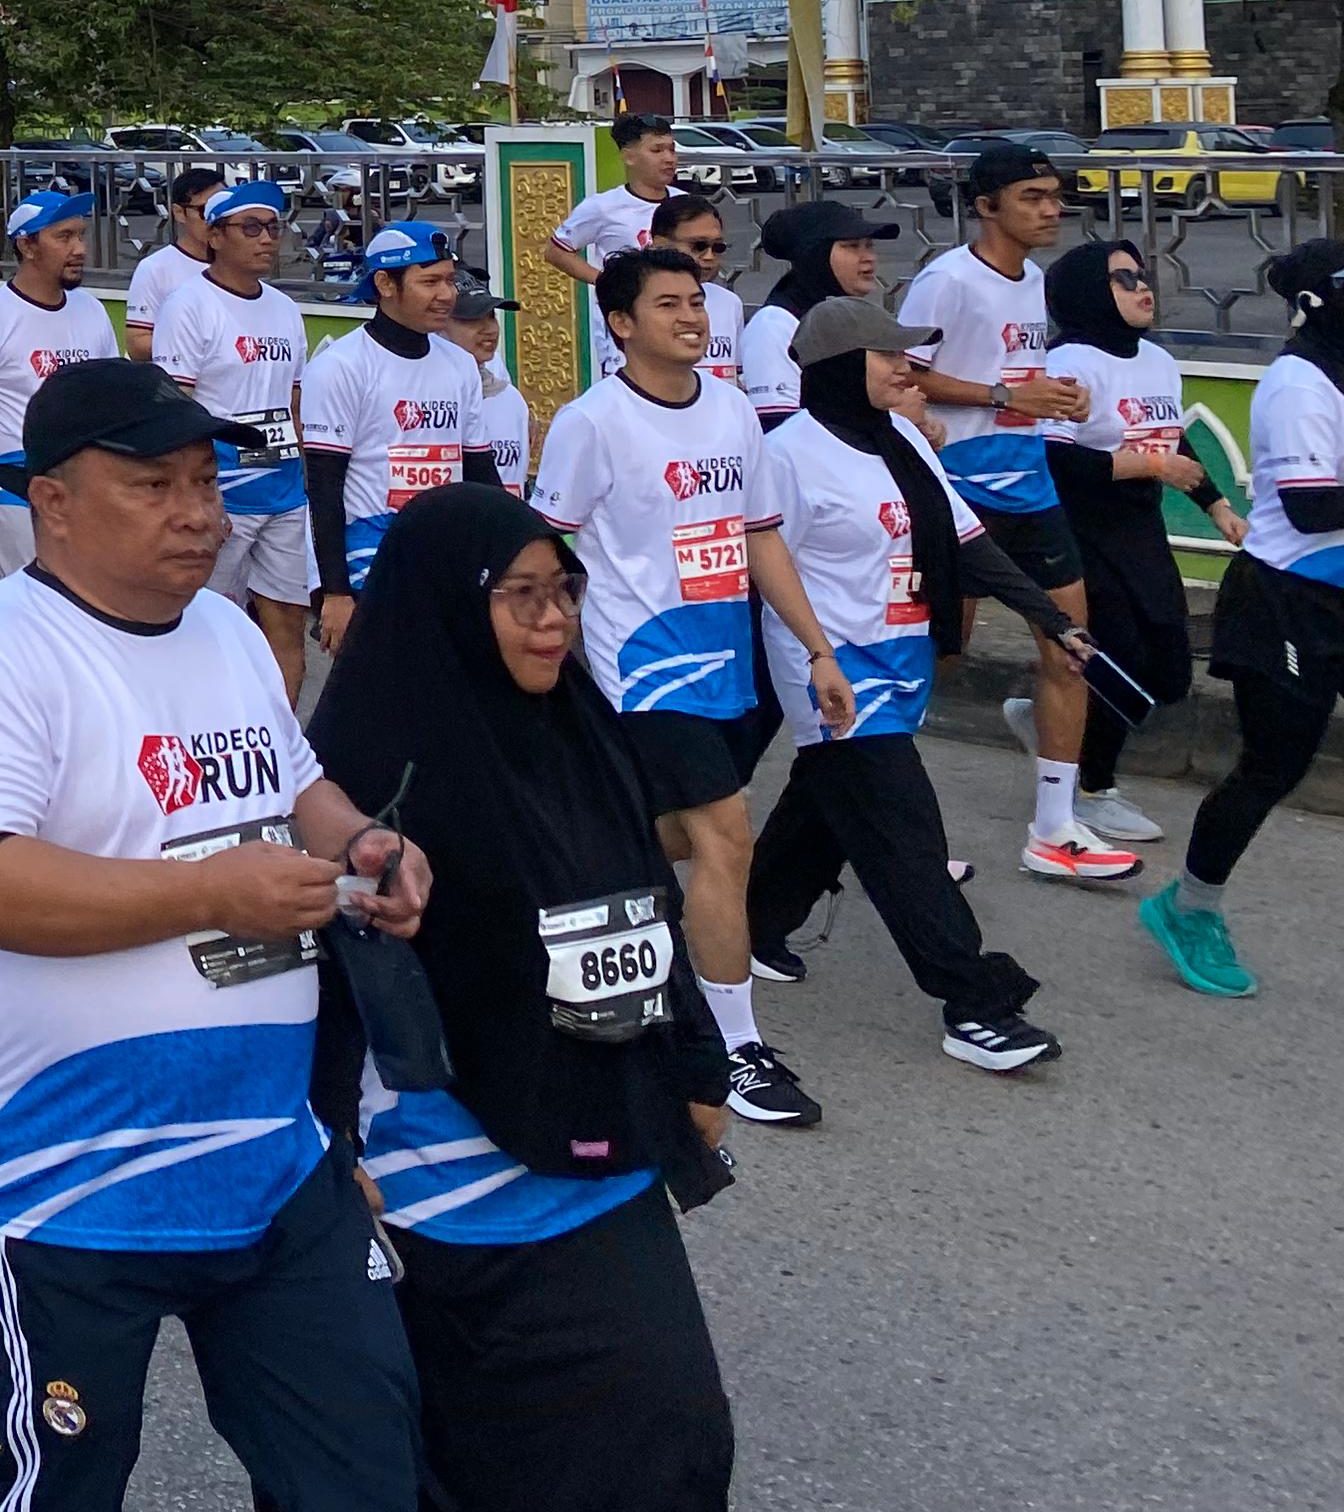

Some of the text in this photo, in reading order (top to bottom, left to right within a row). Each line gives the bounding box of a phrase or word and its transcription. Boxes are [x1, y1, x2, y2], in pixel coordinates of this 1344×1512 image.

[257, 337, 291, 346] KIDECO
[256, 346, 292, 362] RUN
[421, 400, 459, 411] KIDECO
[1143, 405, 1179, 421] RUN
[420, 410, 458, 429] RUN
[697, 456, 743, 471] KIDECO
[391, 466, 453, 487] M 5062
[697, 467, 744, 495] RUN
[677, 542, 745, 571] M 5721
[191, 726, 272, 756] KIDECO
[197, 748, 281, 804] RUN
[580, 939, 657, 991] 8660
